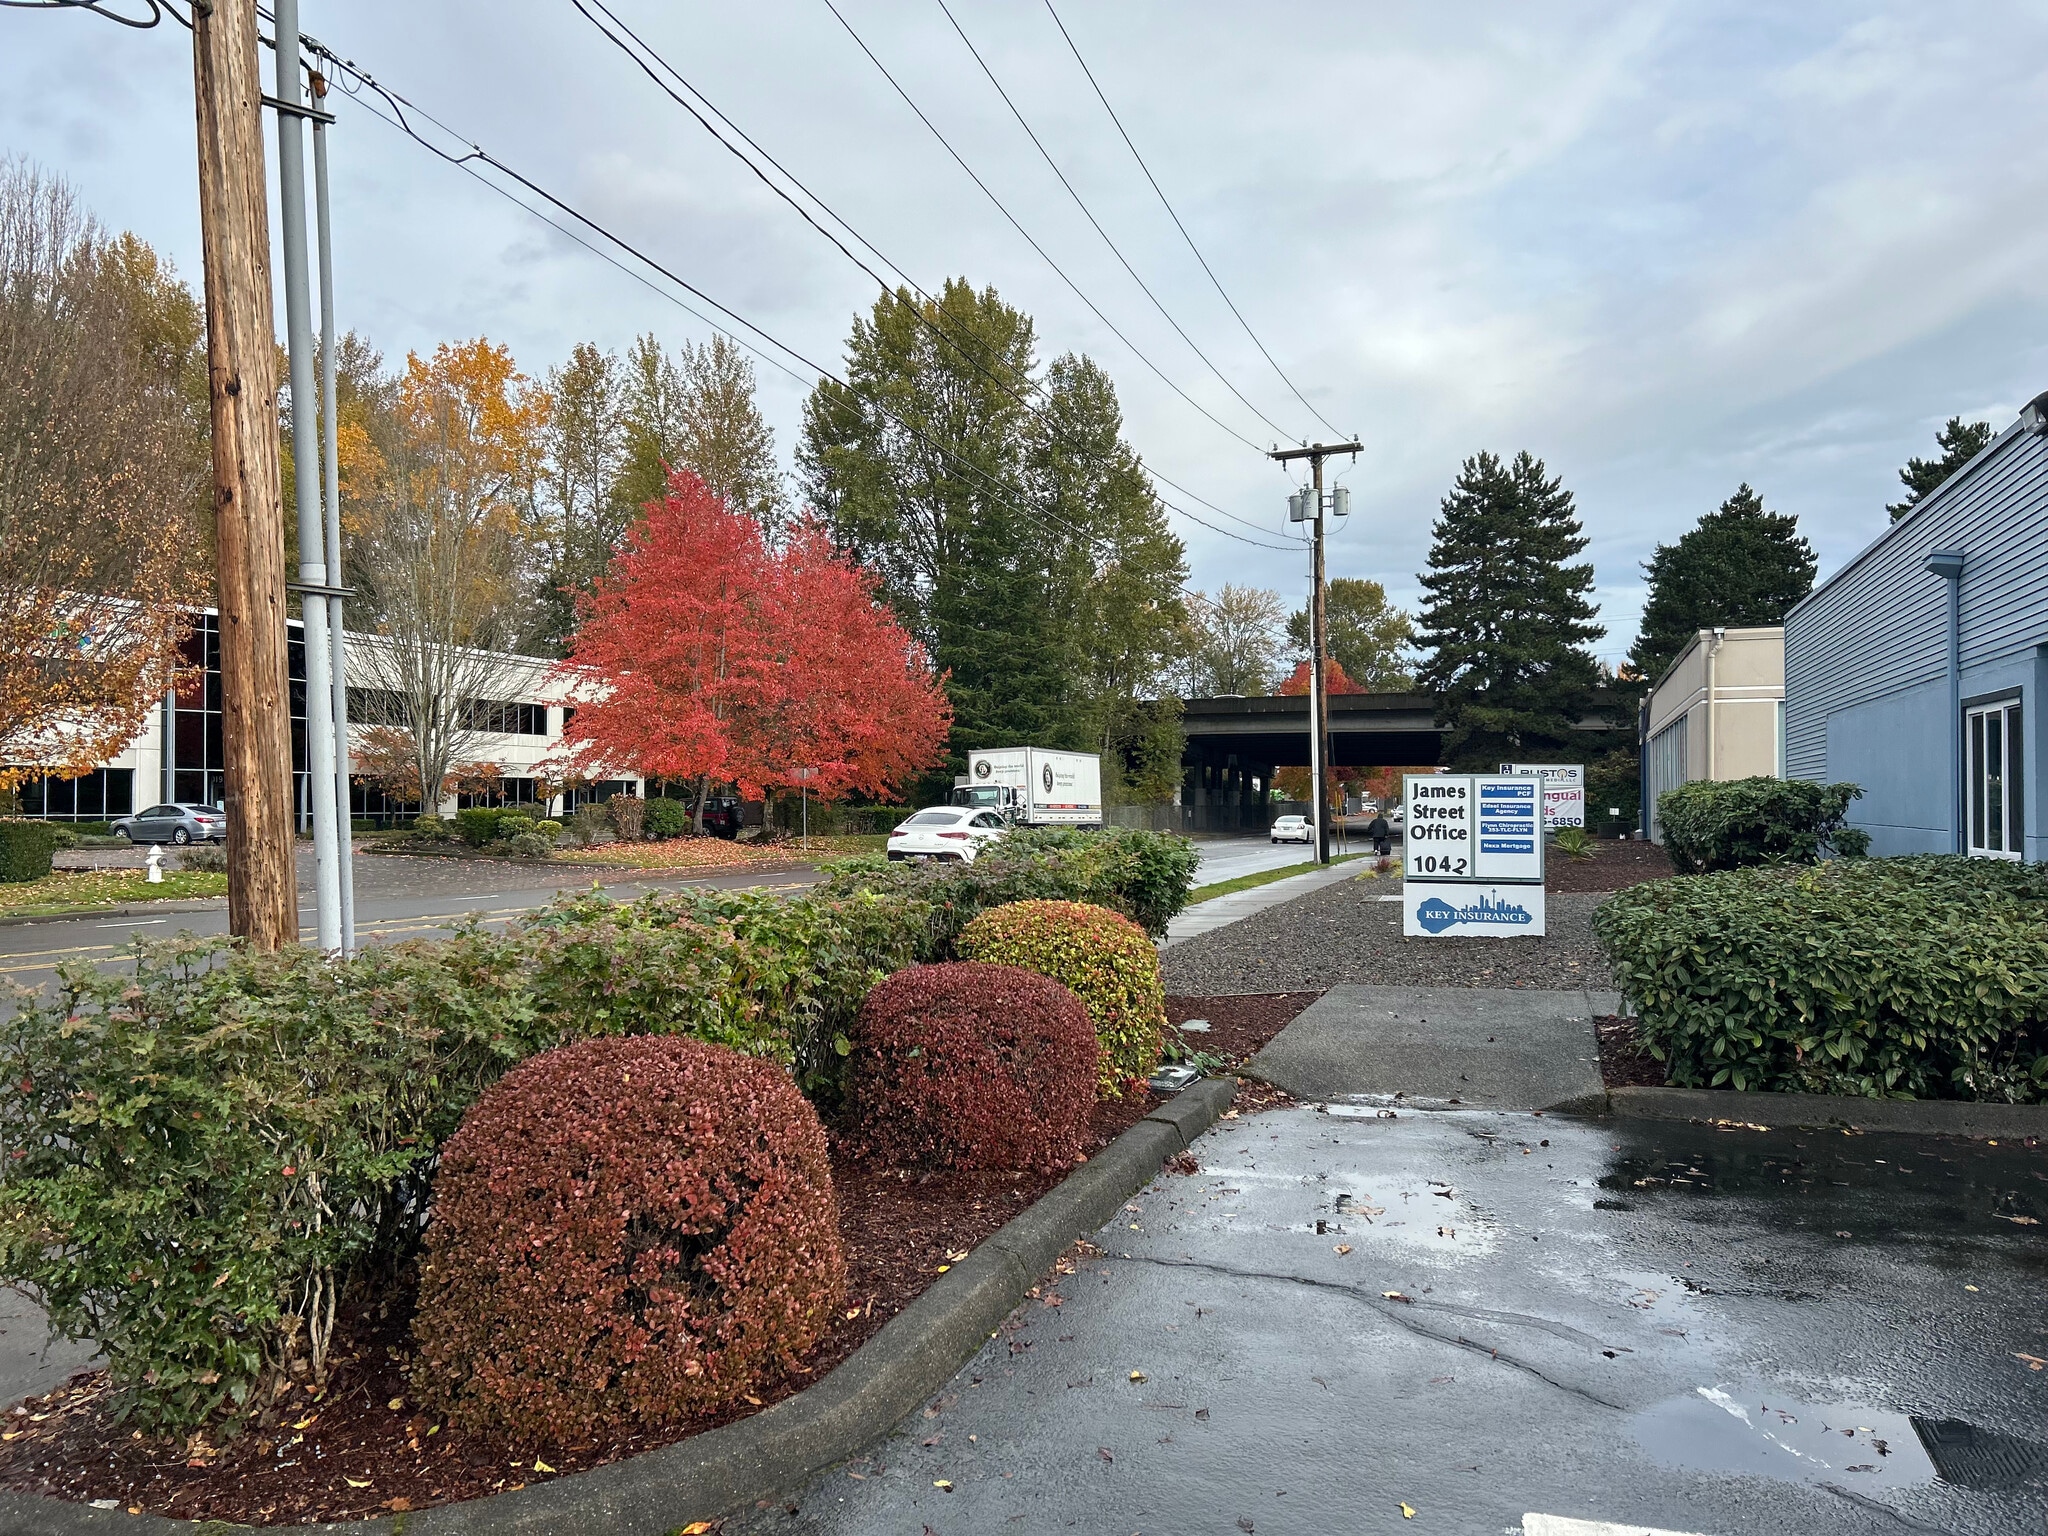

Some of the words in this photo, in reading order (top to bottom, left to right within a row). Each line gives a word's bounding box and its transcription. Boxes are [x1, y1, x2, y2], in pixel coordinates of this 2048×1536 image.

[1412, 783, 1466, 800] James
[1544, 791, 1581, 802] ngual
[1413, 804, 1465, 820] Street
[1544, 806, 1556, 816] ds
[1544, 817, 1582, 826] 5-6850
[1410, 824, 1467, 840] Office
[1413, 856, 1468, 875] 1042
[1425, 911, 1450, 919] KEY
[1453, 911, 1526, 922] INSURANCE
